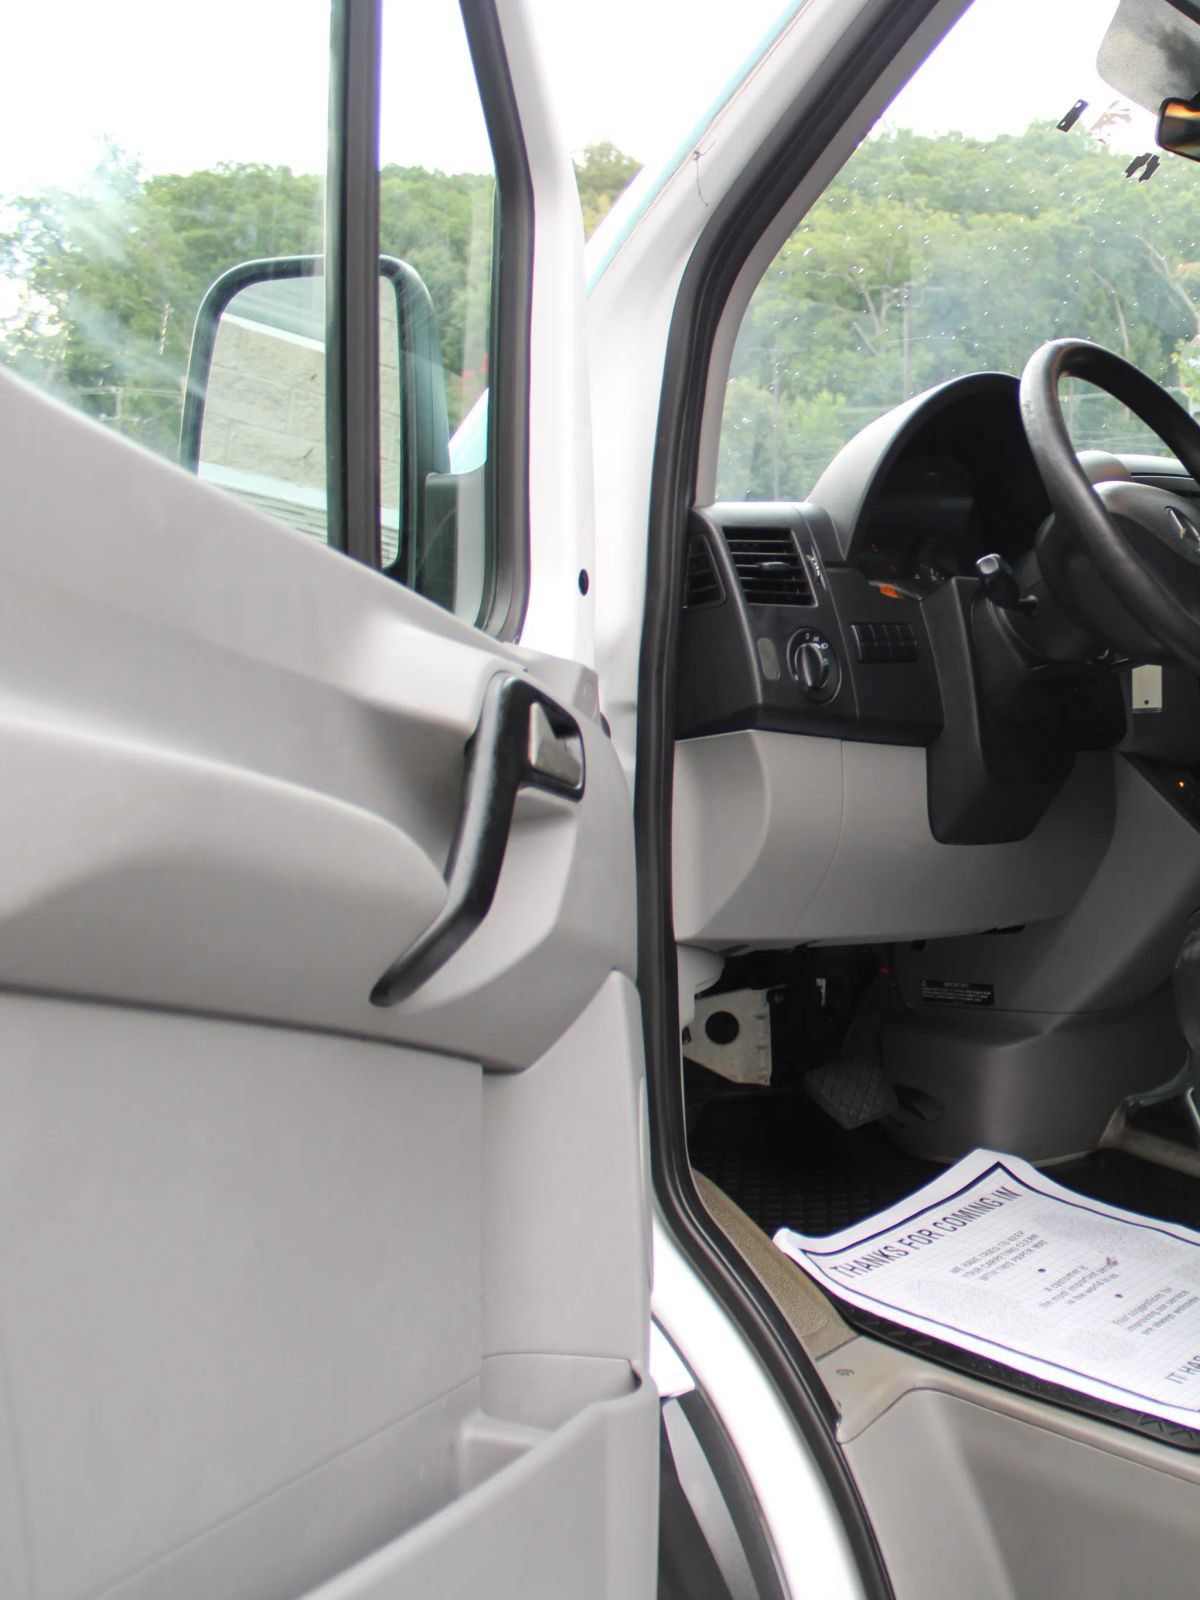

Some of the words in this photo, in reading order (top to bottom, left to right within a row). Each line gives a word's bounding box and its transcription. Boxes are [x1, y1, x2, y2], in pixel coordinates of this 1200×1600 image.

[829, 1245, 910, 1278] THANKS
[898, 1228, 944, 1250] FOR
[933, 1197, 1004, 1232] COMING
[991, 1186, 1023, 1201] IN
[962, 1257, 980, 1268] HAVE
[963, 1267, 983, 1277] YOUR
[1016, 1234, 1040, 1247] CLEAN
[1011, 1248, 1036, 1262] PAPER
[1050, 1268, 1081, 1288] customer
[1051, 1290, 1070, 1302] most
[1068, 1272, 1100, 1292] important
[1086, 1281, 1105, 1293] world
[1112, 1315, 1129, 1326] Your
[1128, 1293, 1166, 1316] suggestions
[1127, 1311, 1161, 1331] improving
[1166, 1290, 1190, 1305] service
[1152, 1313, 1176, 1328] always
[1173, 1296, 1200, 1314] welcome
[1165, 1372, 1188, 1385] IT
